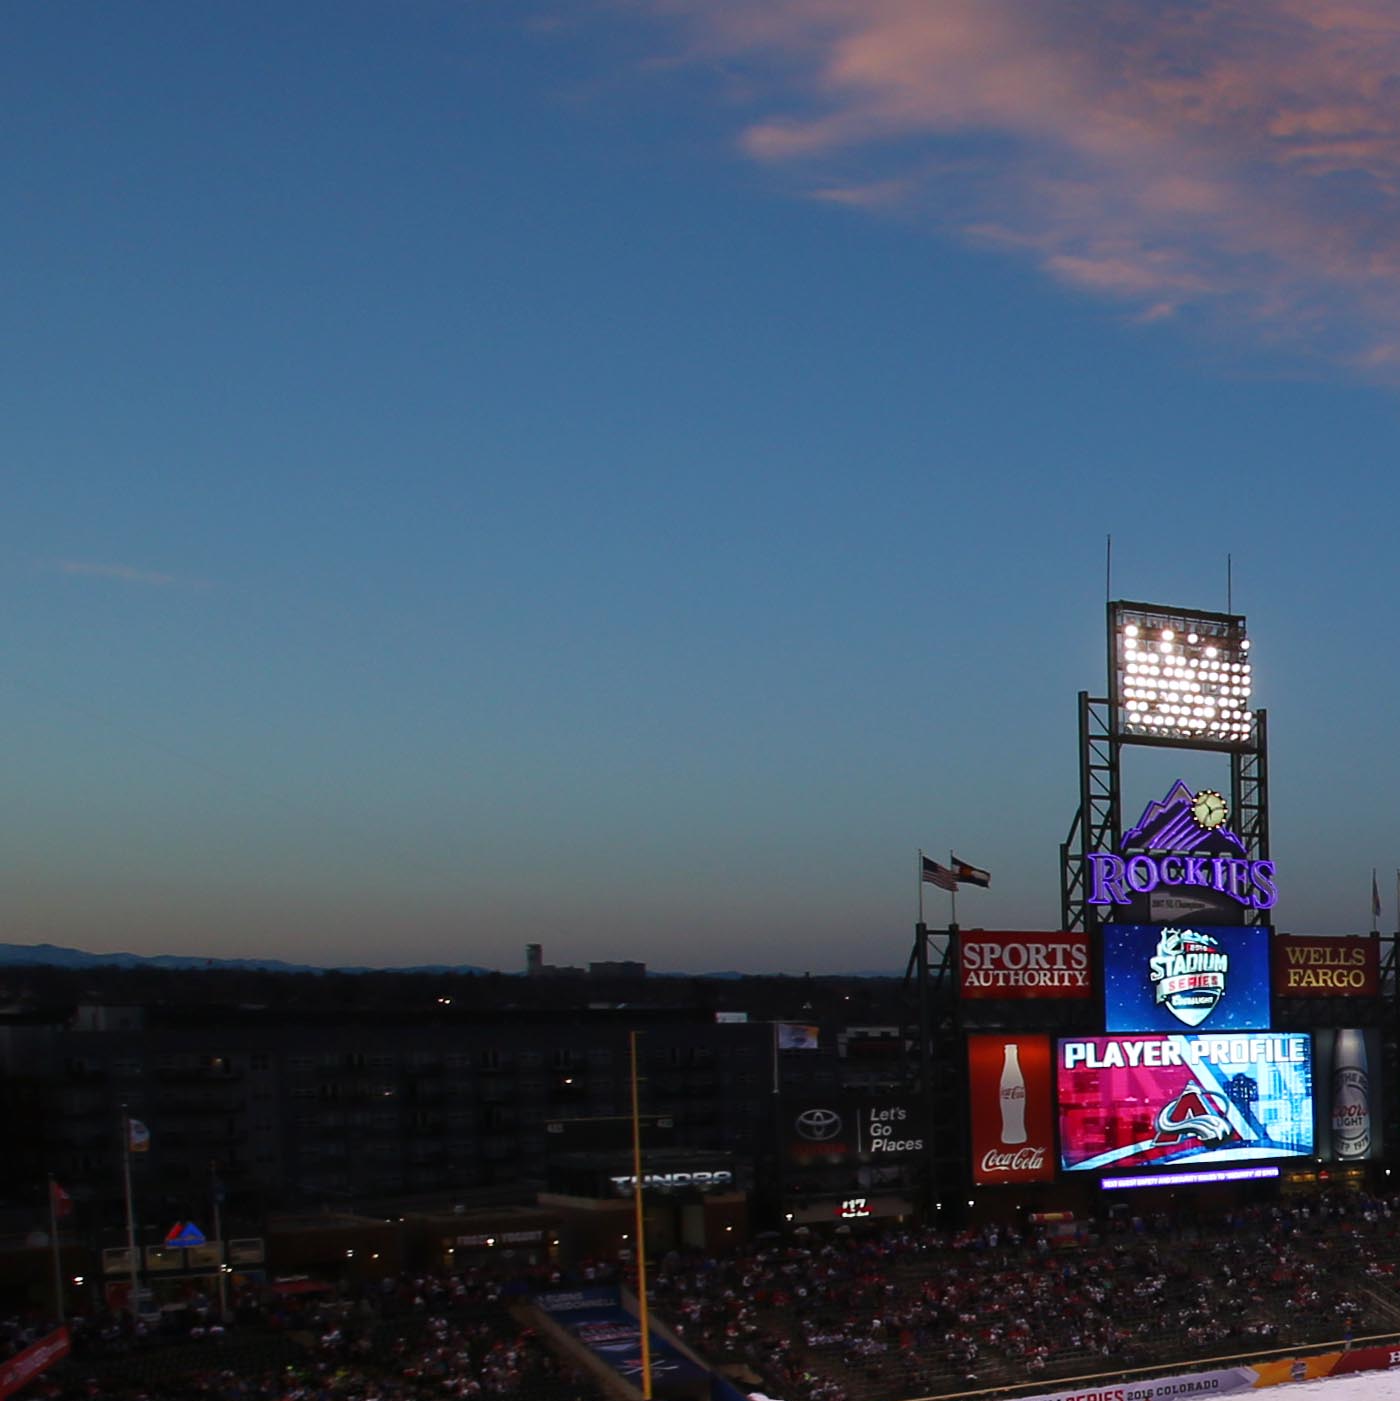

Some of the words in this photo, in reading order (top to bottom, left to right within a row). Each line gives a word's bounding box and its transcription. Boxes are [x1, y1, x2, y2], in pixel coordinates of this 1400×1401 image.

[1088, 853, 1278, 910] ROCKIES
[963, 943, 1087, 969] SPORTS
[1286, 947, 1365, 967] WELLS
[1150, 953, 1228, 981] STADIUM
[965, 970, 1086, 987] AUTHORITY
[1168, 975, 1218, 990] SERIES
[1287, 969, 1365, 988] FARGO
[1065, 1040, 1182, 1069] PLAYER
[1191, 1038, 1305, 1064] PROFILE
[870, 1107, 906, 1122] Let's
[870, 1122, 892, 1137] Go
[871, 1137, 923, 1153] Places
[981, 1146, 1046, 1172] Coca-Cola
[1127, 1386, 1152, 1401] 2016
[1156, 1378, 1220, 1397] COLORADO
